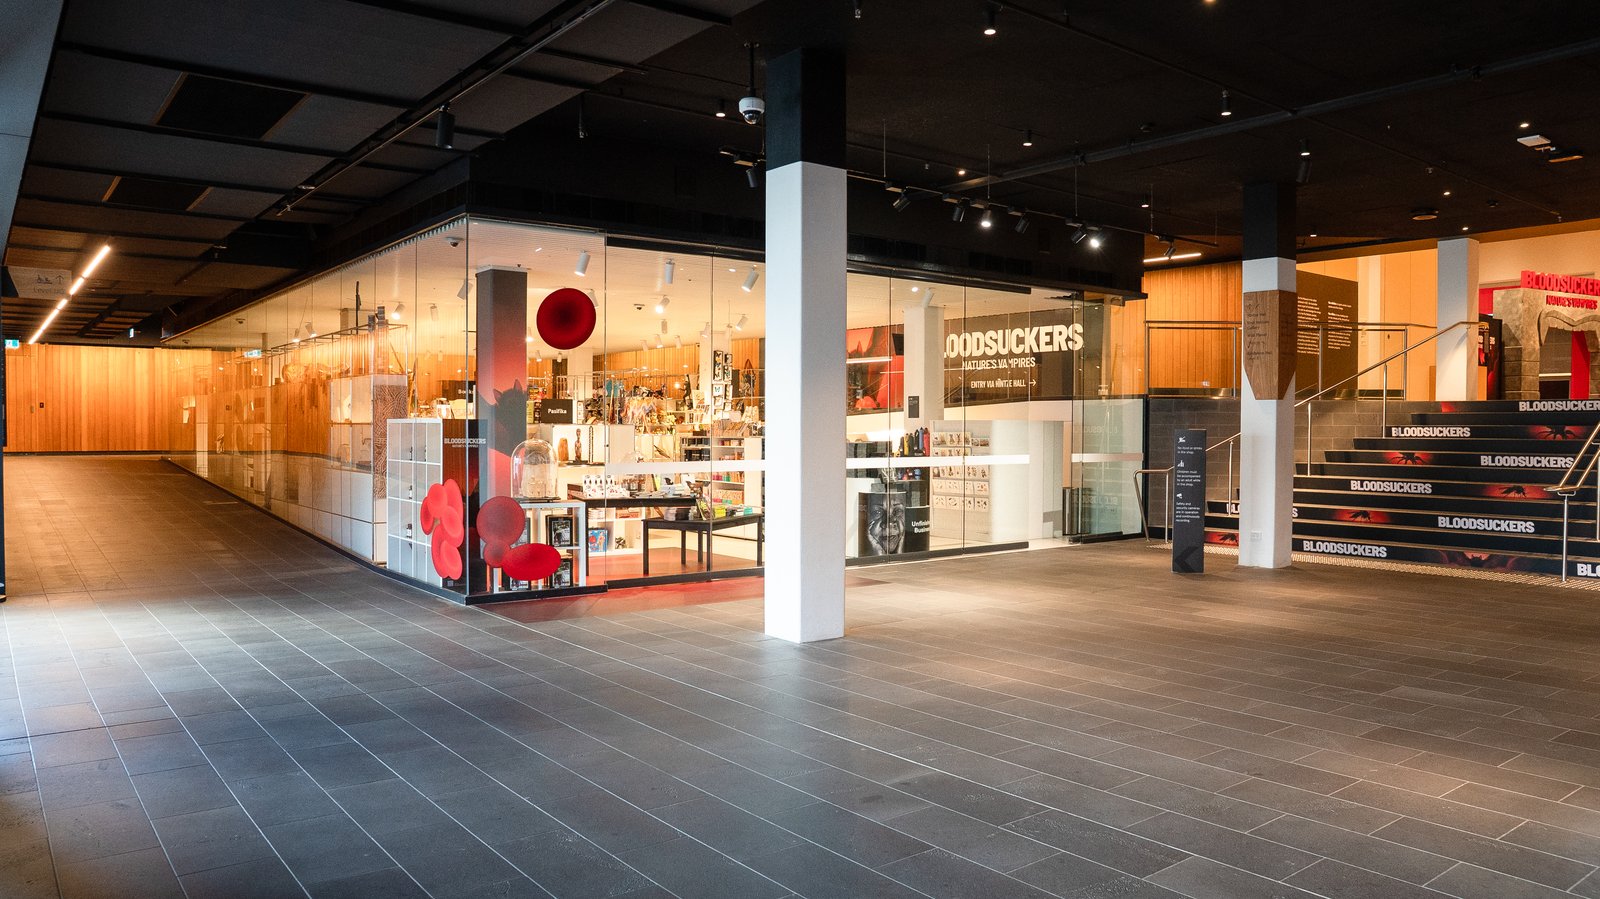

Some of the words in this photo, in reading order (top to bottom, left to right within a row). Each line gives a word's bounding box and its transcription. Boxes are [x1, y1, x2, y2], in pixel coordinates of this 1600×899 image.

[944, 322, 1084, 359] OODSUCKERS
[963, 360, 997, 371] NATURE'S
[998, 357, 1036, 369] VAMPIRES
[971, 381, 986, 389] ENTRY
[1013, 380, 1026, 388] HALL
[1519, 400, 1600, 412] BLOODSUCKER
[1391, 427, 1471, 438] BLOODSUCKERS
[1480, 455, 1574, 468] BLOODSUCKERS
[1350, 480, 1432, 494] BLOODSUCKERS
[1437, 516, 1535, 533] BLOODSUCKERS
[1303, 540, 1387, 558] BLOODSUCKERS
